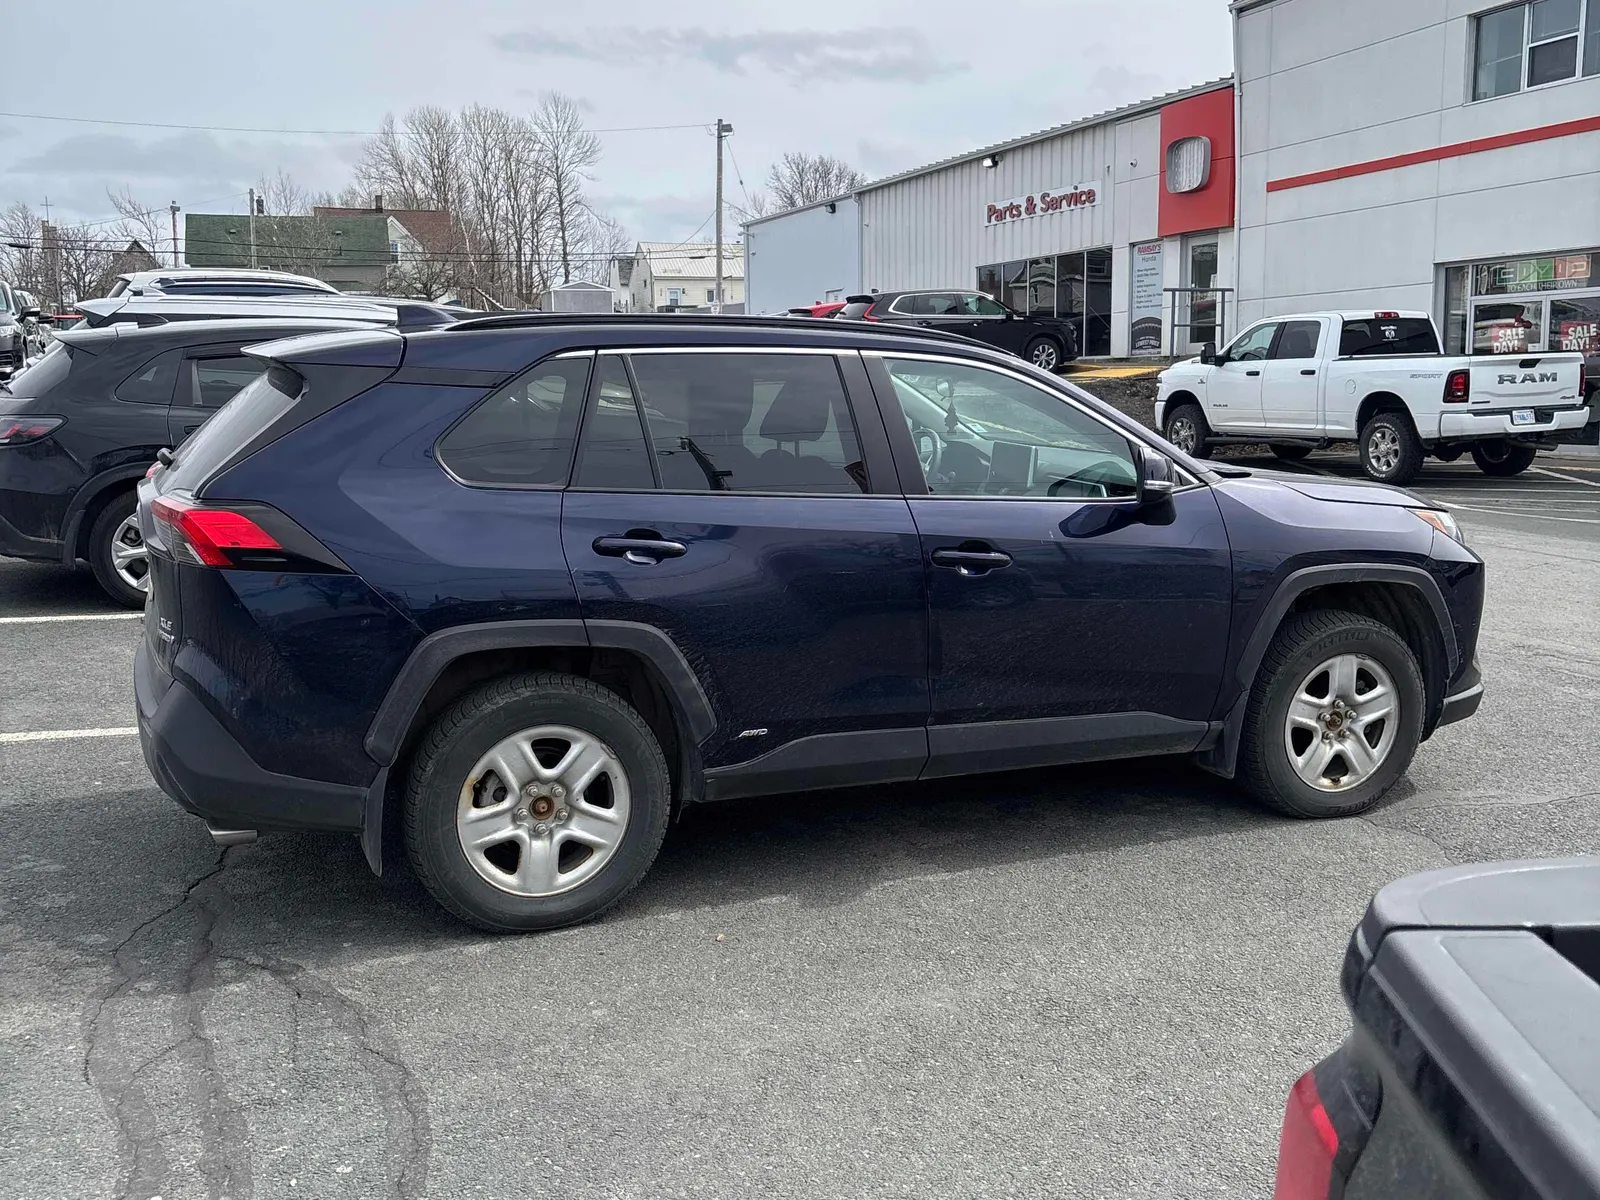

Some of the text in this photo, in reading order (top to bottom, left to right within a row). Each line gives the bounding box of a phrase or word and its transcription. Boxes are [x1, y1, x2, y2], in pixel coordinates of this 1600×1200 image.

[987, 185, 1096, 223] Parts & Service
[1137, 243, 1162, 254] RAMSAY'S
[1141, 255, 1157, 263] Honda
[1517, 283, 1537, 292] EACH
[1538, 281, 1557, 290] THEIR
[1557, 279, 1578, 289] OWN
[1498, 327, 1525, 342] SALE
[1568, 323, 1597, 340] SALE
[1493, 340, 1519, 354] DAY!
[1562, 337, 1590, 351] DAY!
[1497, 372, 1558, 385] RAM
[738, 728, 768, 738] AWD
